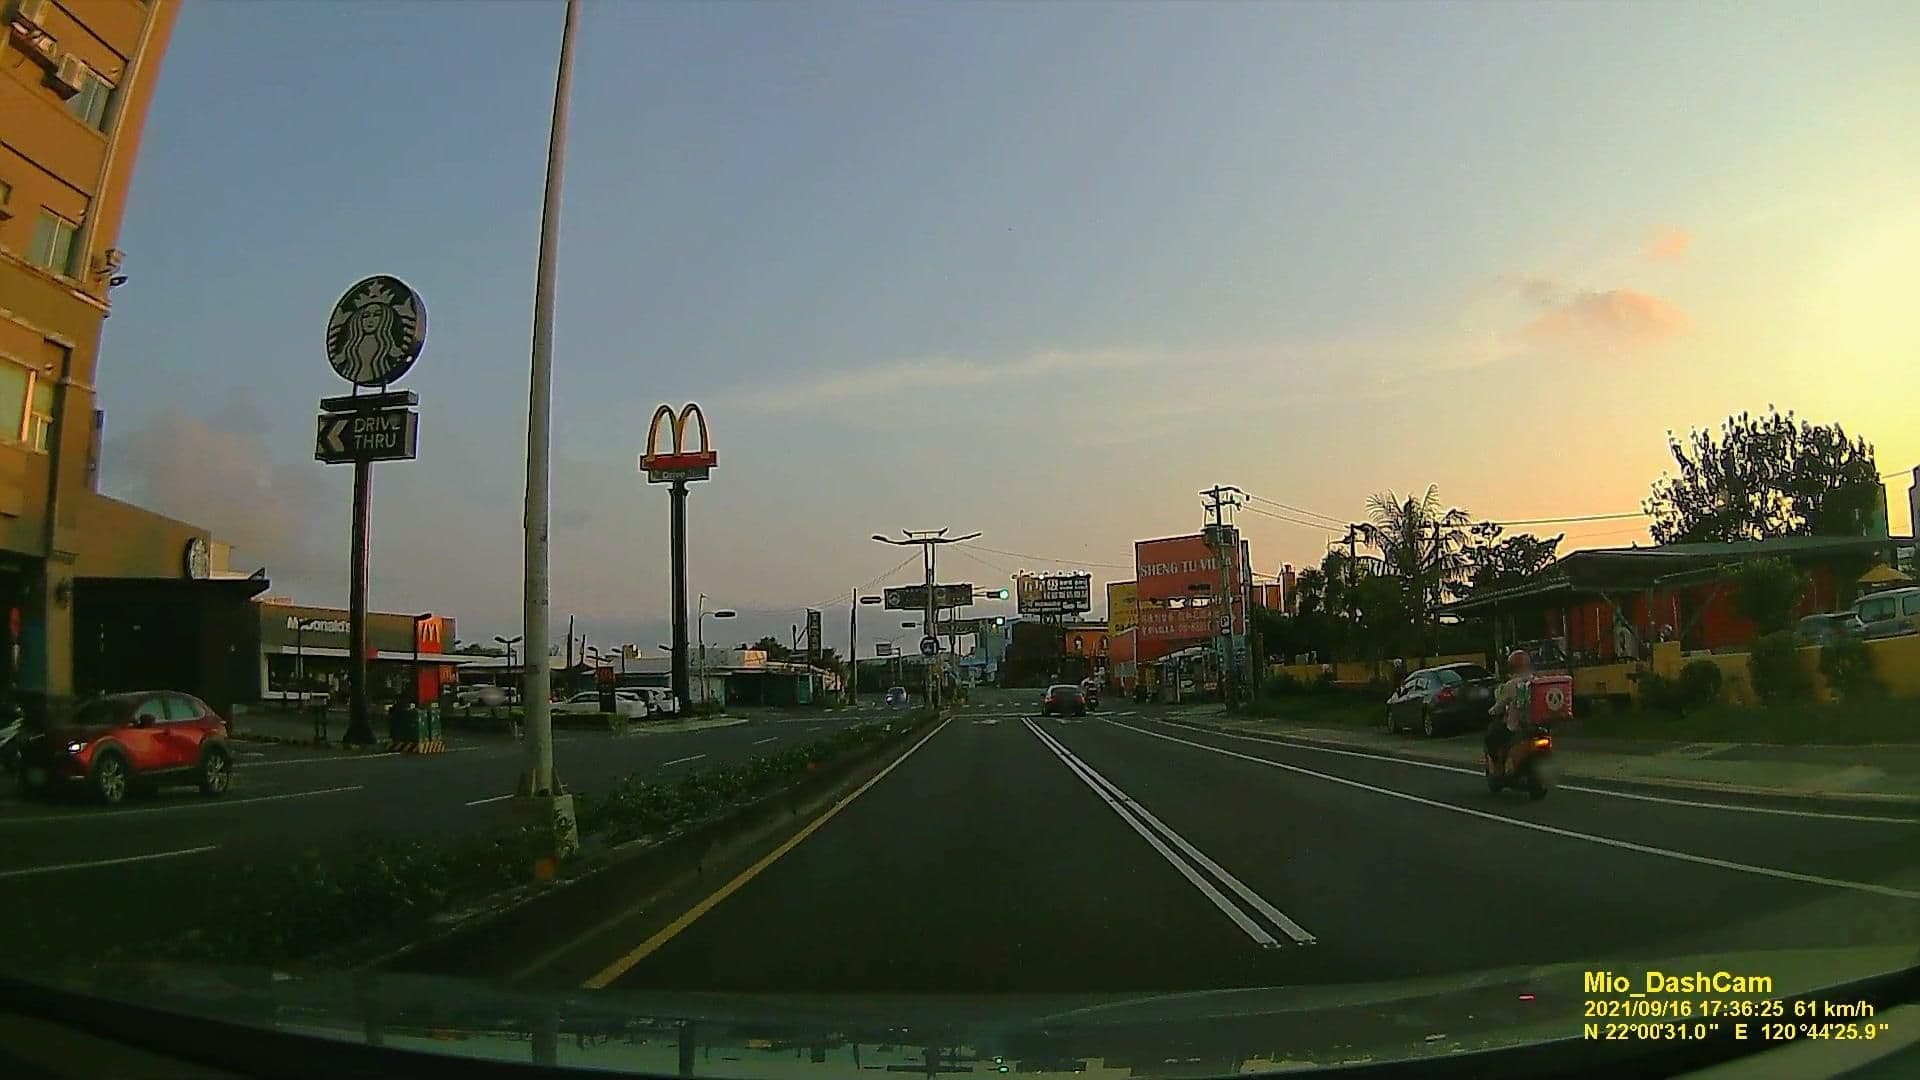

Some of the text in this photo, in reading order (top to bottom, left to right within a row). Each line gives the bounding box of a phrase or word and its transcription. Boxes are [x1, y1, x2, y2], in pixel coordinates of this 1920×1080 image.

[354, 433, 396, 449] THRU
[1141, 557, 1232, 577] SHENG TU VILA
[287, 616, 350, 632] MDonald's
